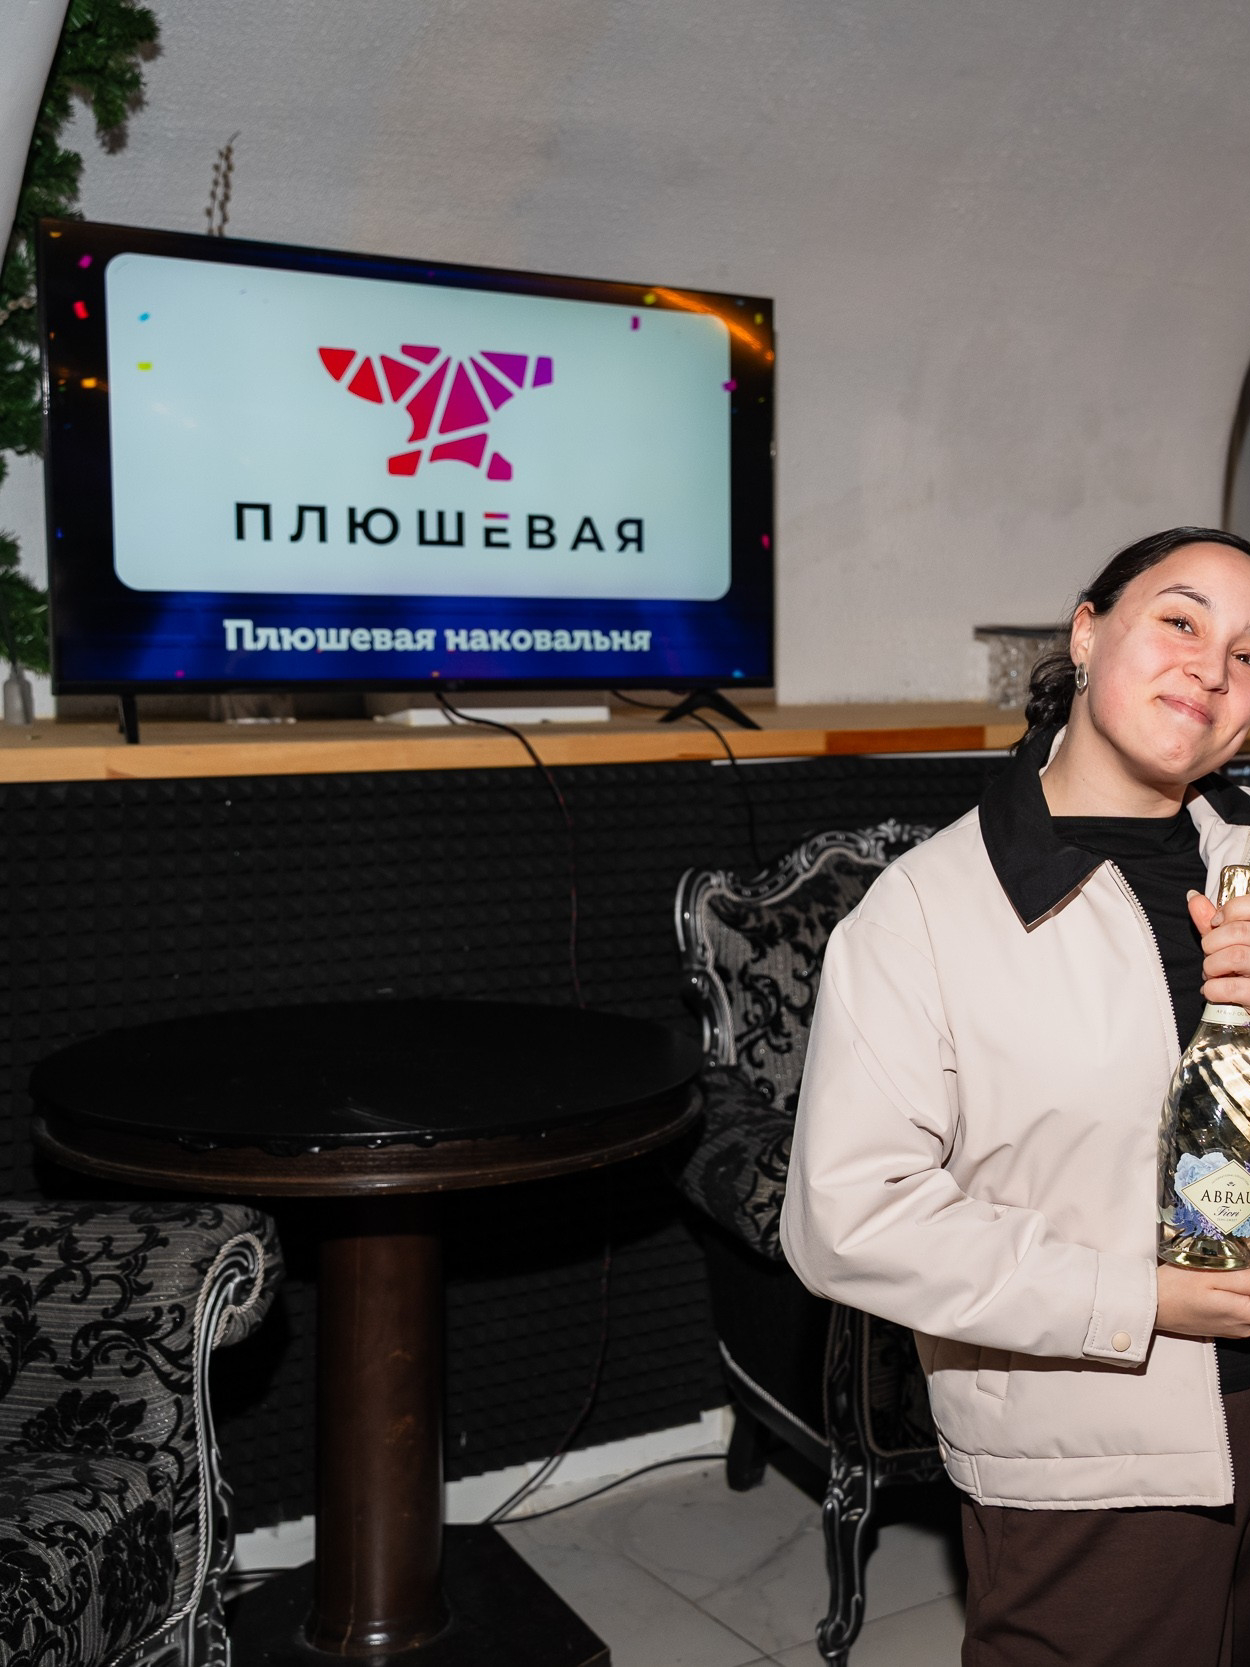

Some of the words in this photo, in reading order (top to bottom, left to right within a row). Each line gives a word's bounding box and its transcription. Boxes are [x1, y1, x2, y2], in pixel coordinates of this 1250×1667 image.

[235, 502, 645, 553] ПЛЮШЕВАЯ
[223, 619, 436, 652] Плюшевая
[444, 625, 652, 652] наковальня
